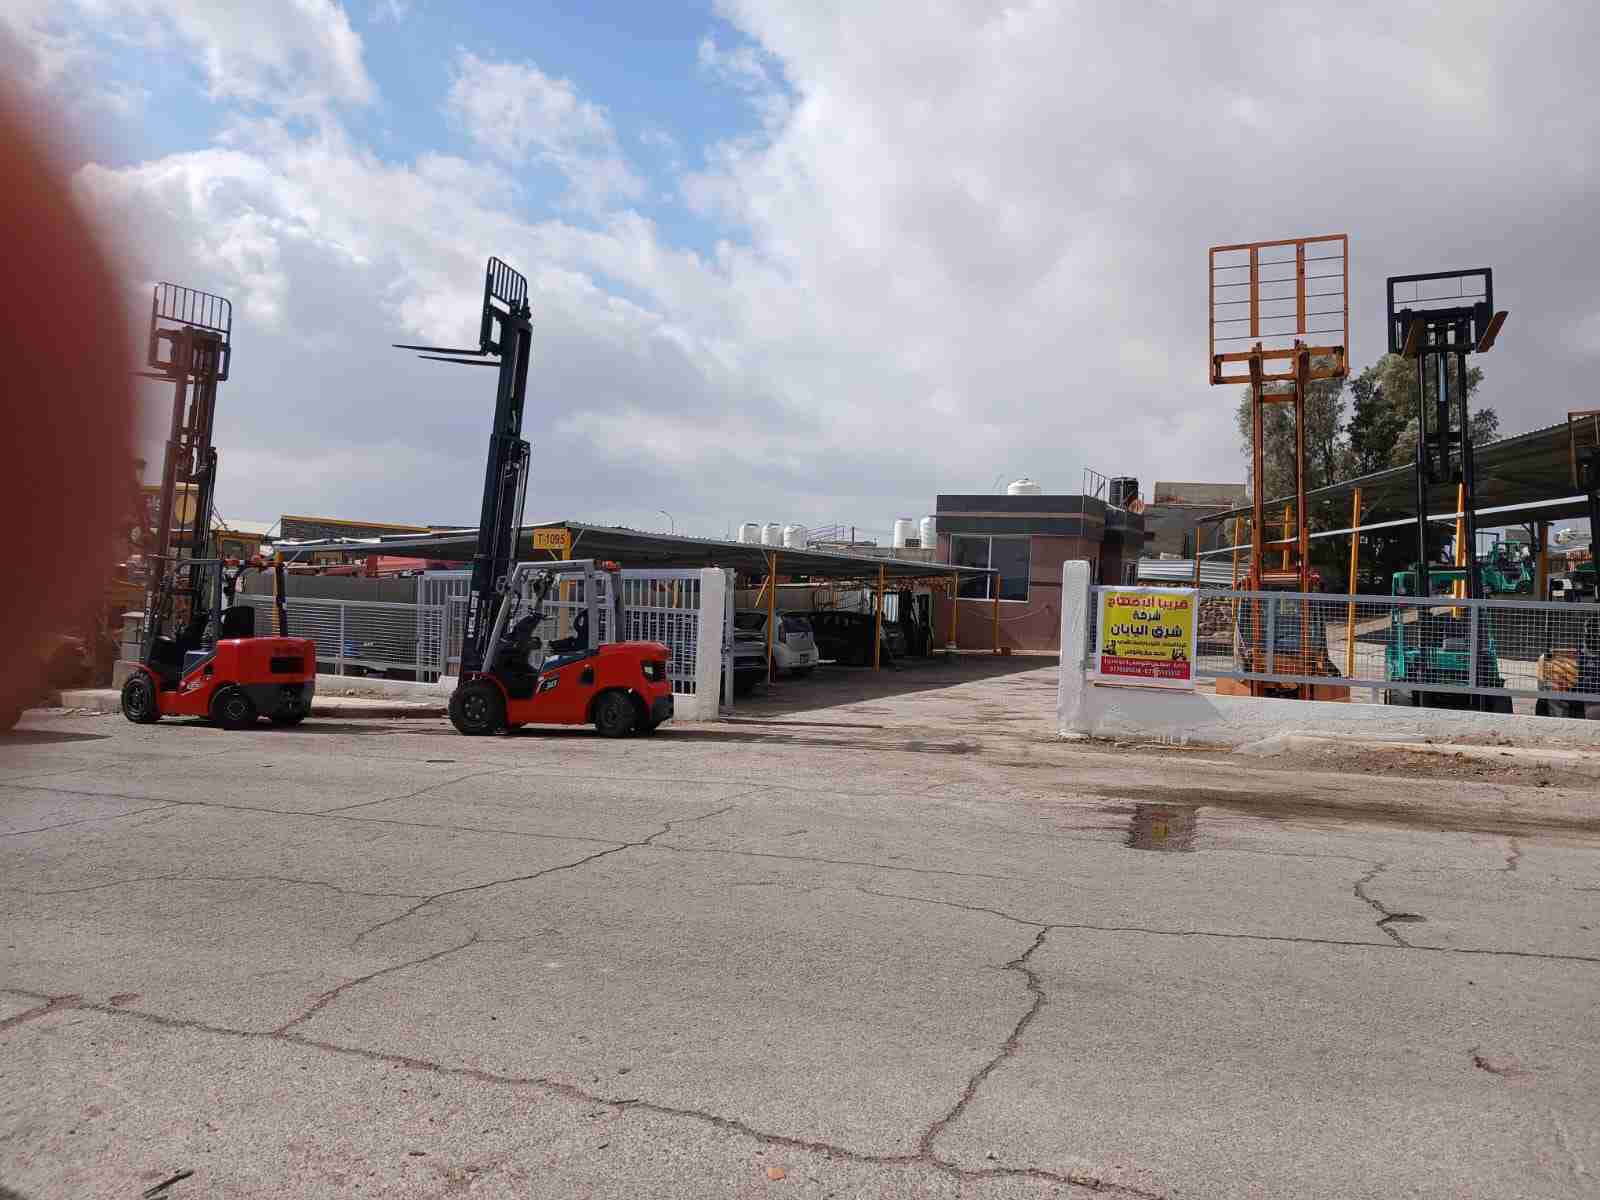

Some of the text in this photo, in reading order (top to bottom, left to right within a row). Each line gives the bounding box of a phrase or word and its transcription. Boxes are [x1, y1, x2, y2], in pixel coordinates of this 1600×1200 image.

[1132, 609, 1161, 622] شركة
[1111, 623, 1182, 638] شرق اليابان
